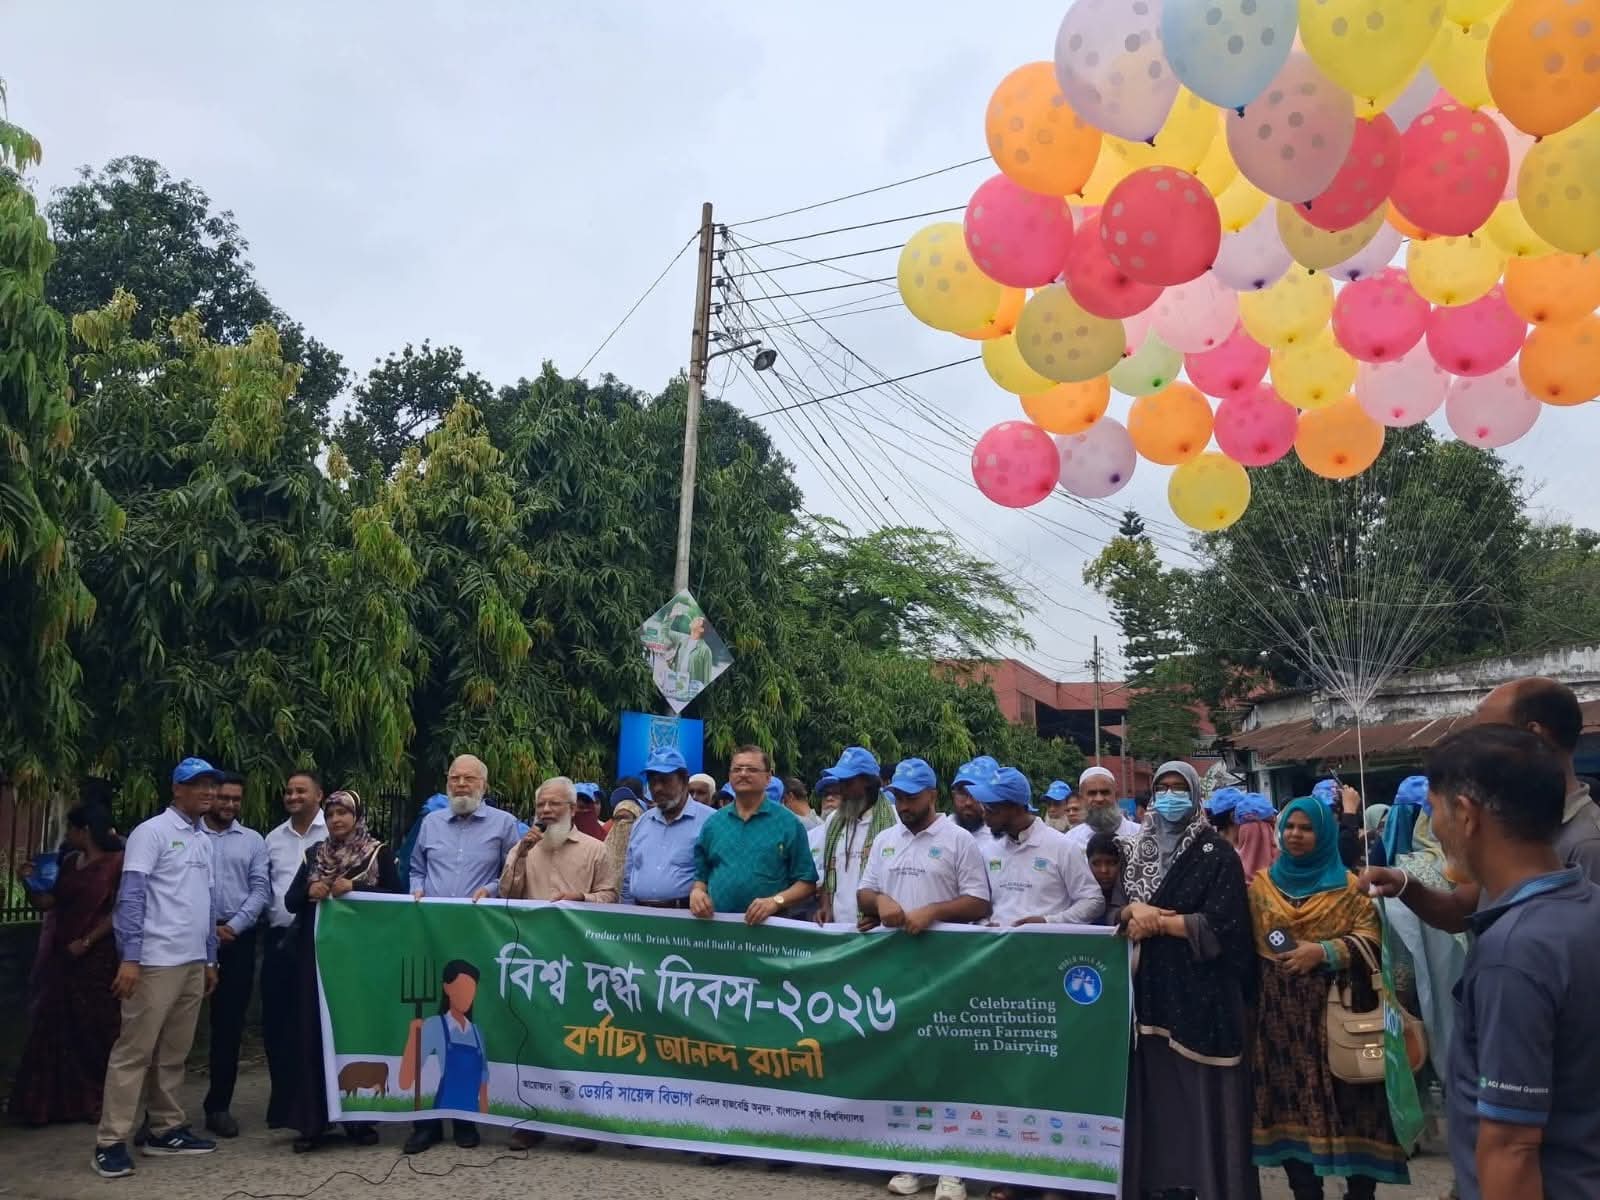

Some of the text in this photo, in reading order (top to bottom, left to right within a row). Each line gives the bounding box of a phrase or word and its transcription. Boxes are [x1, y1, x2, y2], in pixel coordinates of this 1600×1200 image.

[584, 929, 620, 941] Produce
[646, 934, 671, 945] Drink
[671, 936, 691, 948] Milk
[693, 938, 710, 949] and
[711, 940, 736, 951] Build
[745, 941, 780, 955] Healthy
[781, 945, 812, 959] Nation
[494, 942, 897, 1038] বিশ্ব দুগ্ধ দিবস-২০২৬
[969, 997, 1056, 1013] Celebrating
[933, 1011, 1057, 1024] the Contribution
[563, 1015, 647, 1064] বর্ণাঢ্য
[653, 1033, 739, 1071] আনন্দ
[917, 1025, 1058, 1039] of Women Farmers
[974, 1040, 1058, 1057] in Dairying
[658, 1084, 693, 1107] বিভাগ
[775, 1105, 806, 1119] বাংলাদেশ
